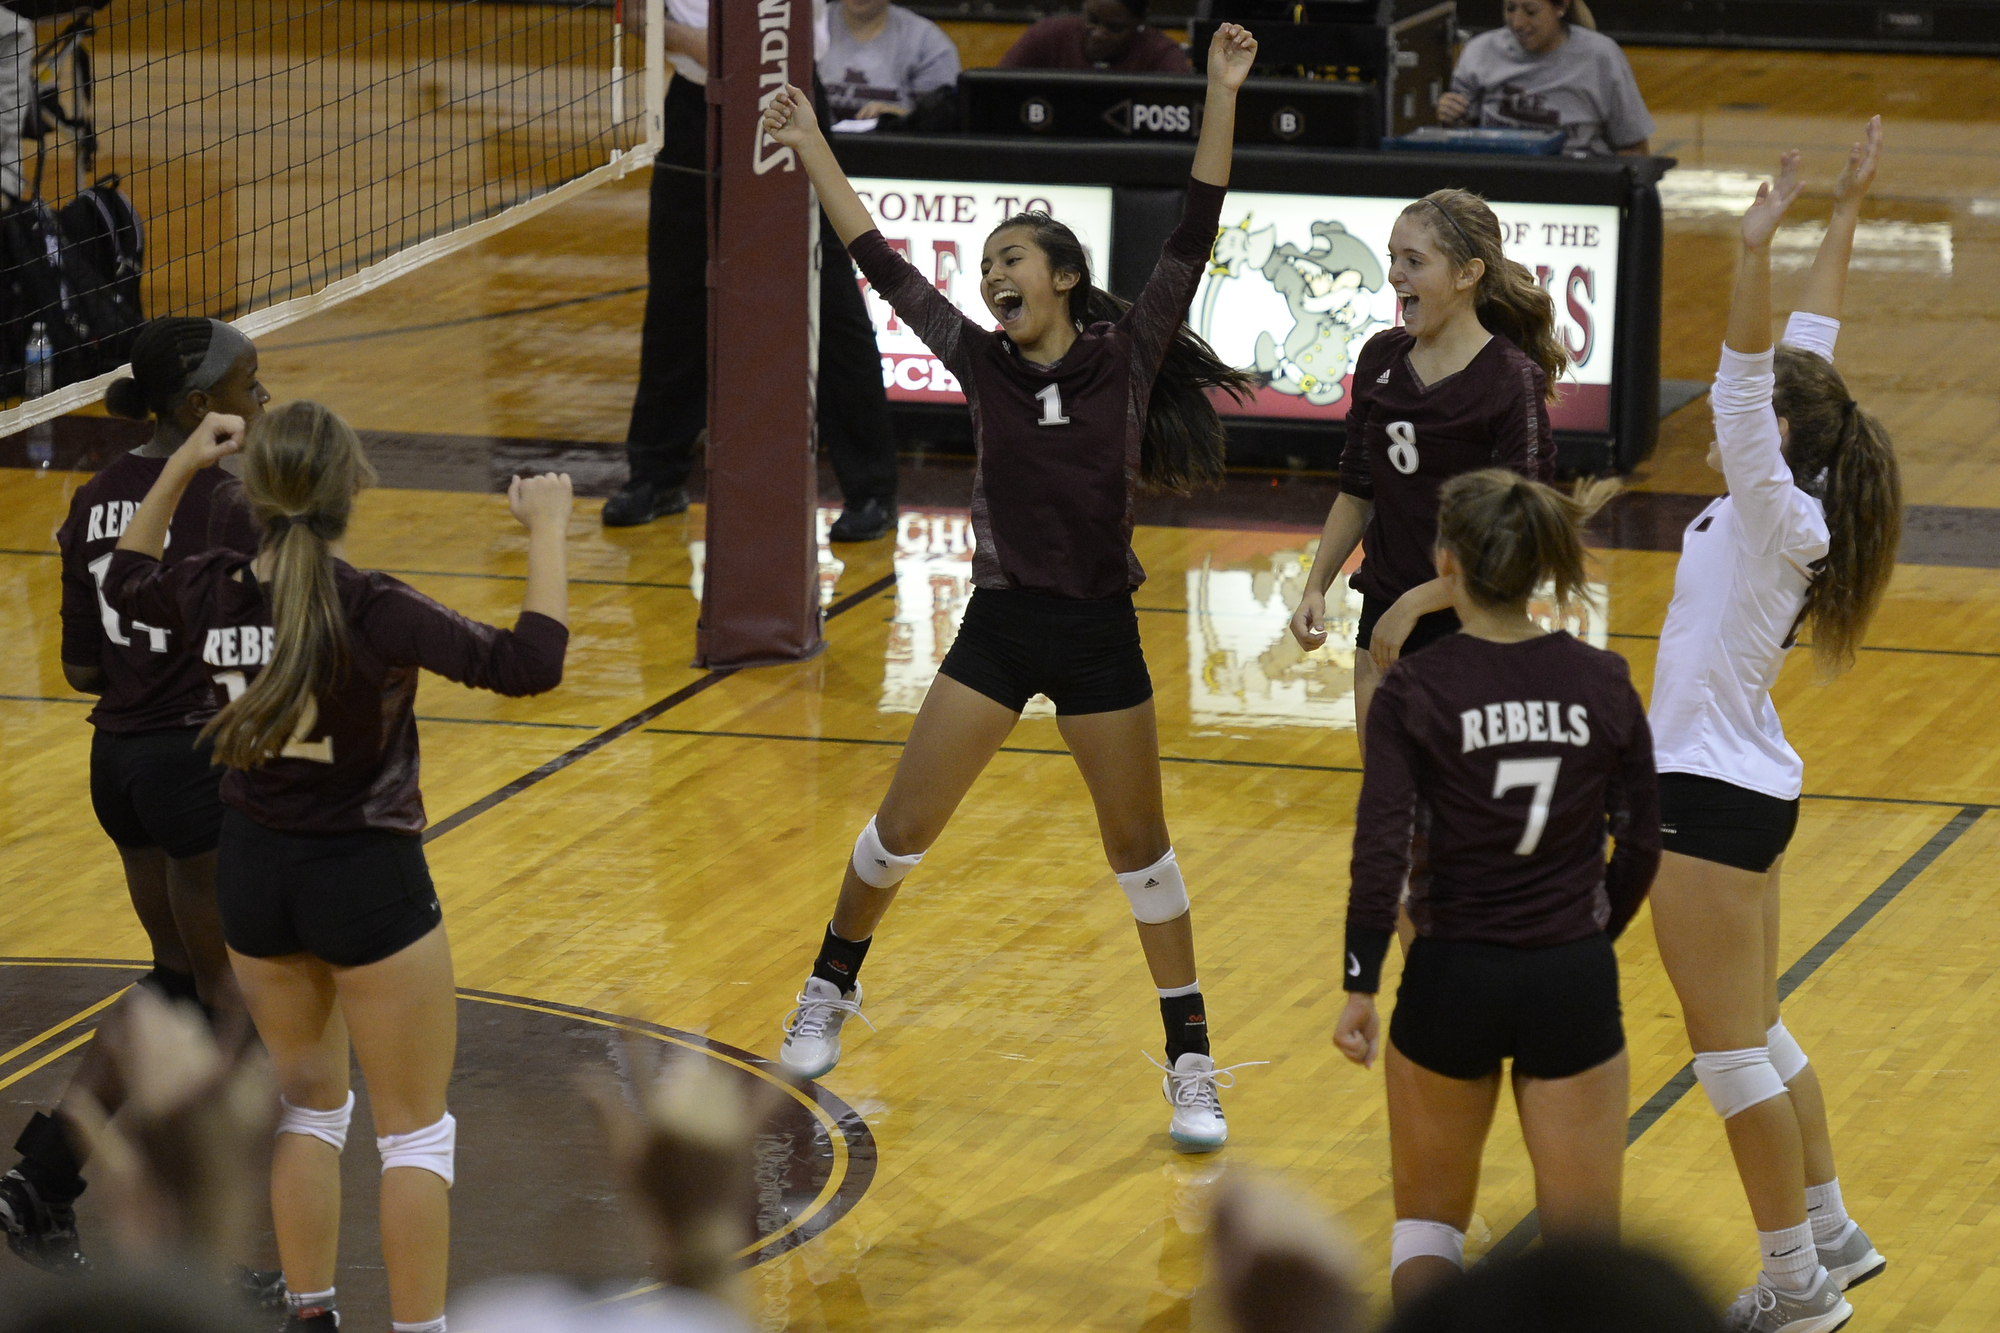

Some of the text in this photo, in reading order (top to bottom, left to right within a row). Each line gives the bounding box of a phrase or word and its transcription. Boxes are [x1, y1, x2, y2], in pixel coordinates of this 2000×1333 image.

[1028, 103, 1045, 122] B
[1132, 104, 1191, 132] POSS
[1280, 113, 1297, 132] B
[1542, 223, 1600, 248] THE
[1035, 382, 1070, 426] 1
[1386, 421, 1419, 475] 8
[1459, 700, 1591, 754] REBELS
[1491, 756, 1562, 856] 7
